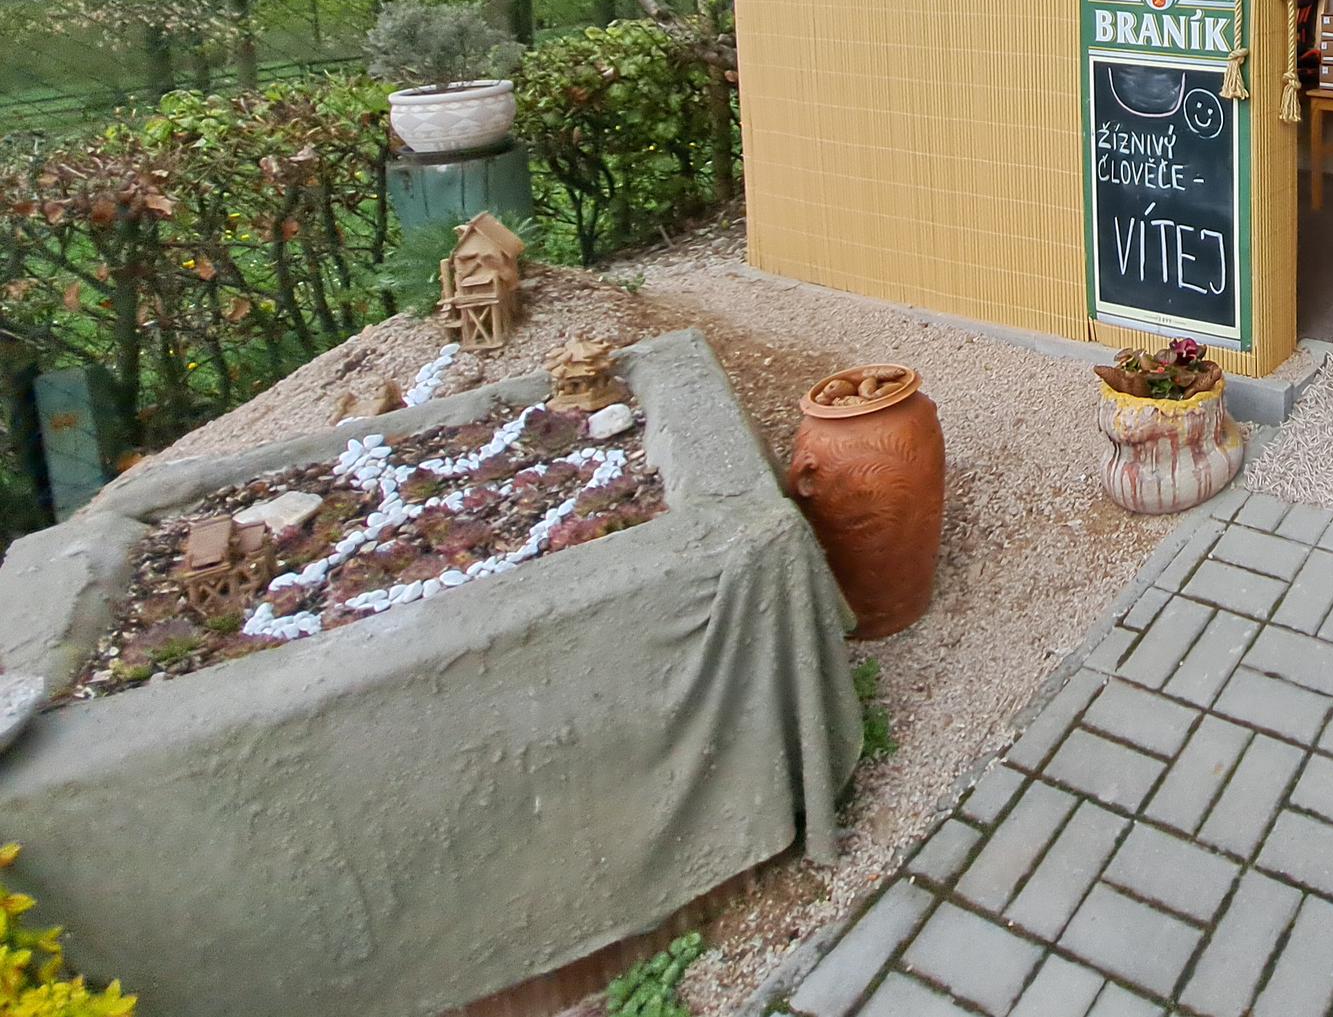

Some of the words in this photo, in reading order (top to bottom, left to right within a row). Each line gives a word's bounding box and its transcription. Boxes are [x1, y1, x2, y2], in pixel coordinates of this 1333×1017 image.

[1095, 9, 1231, 52] BRANÍK
[1098, 121, 1177, 159] ŽÍZNIVÝ
[1097, 153, 1186, 191] ČLOVĚČE
[1114, 202, 1226, 295] VÍTEJ
